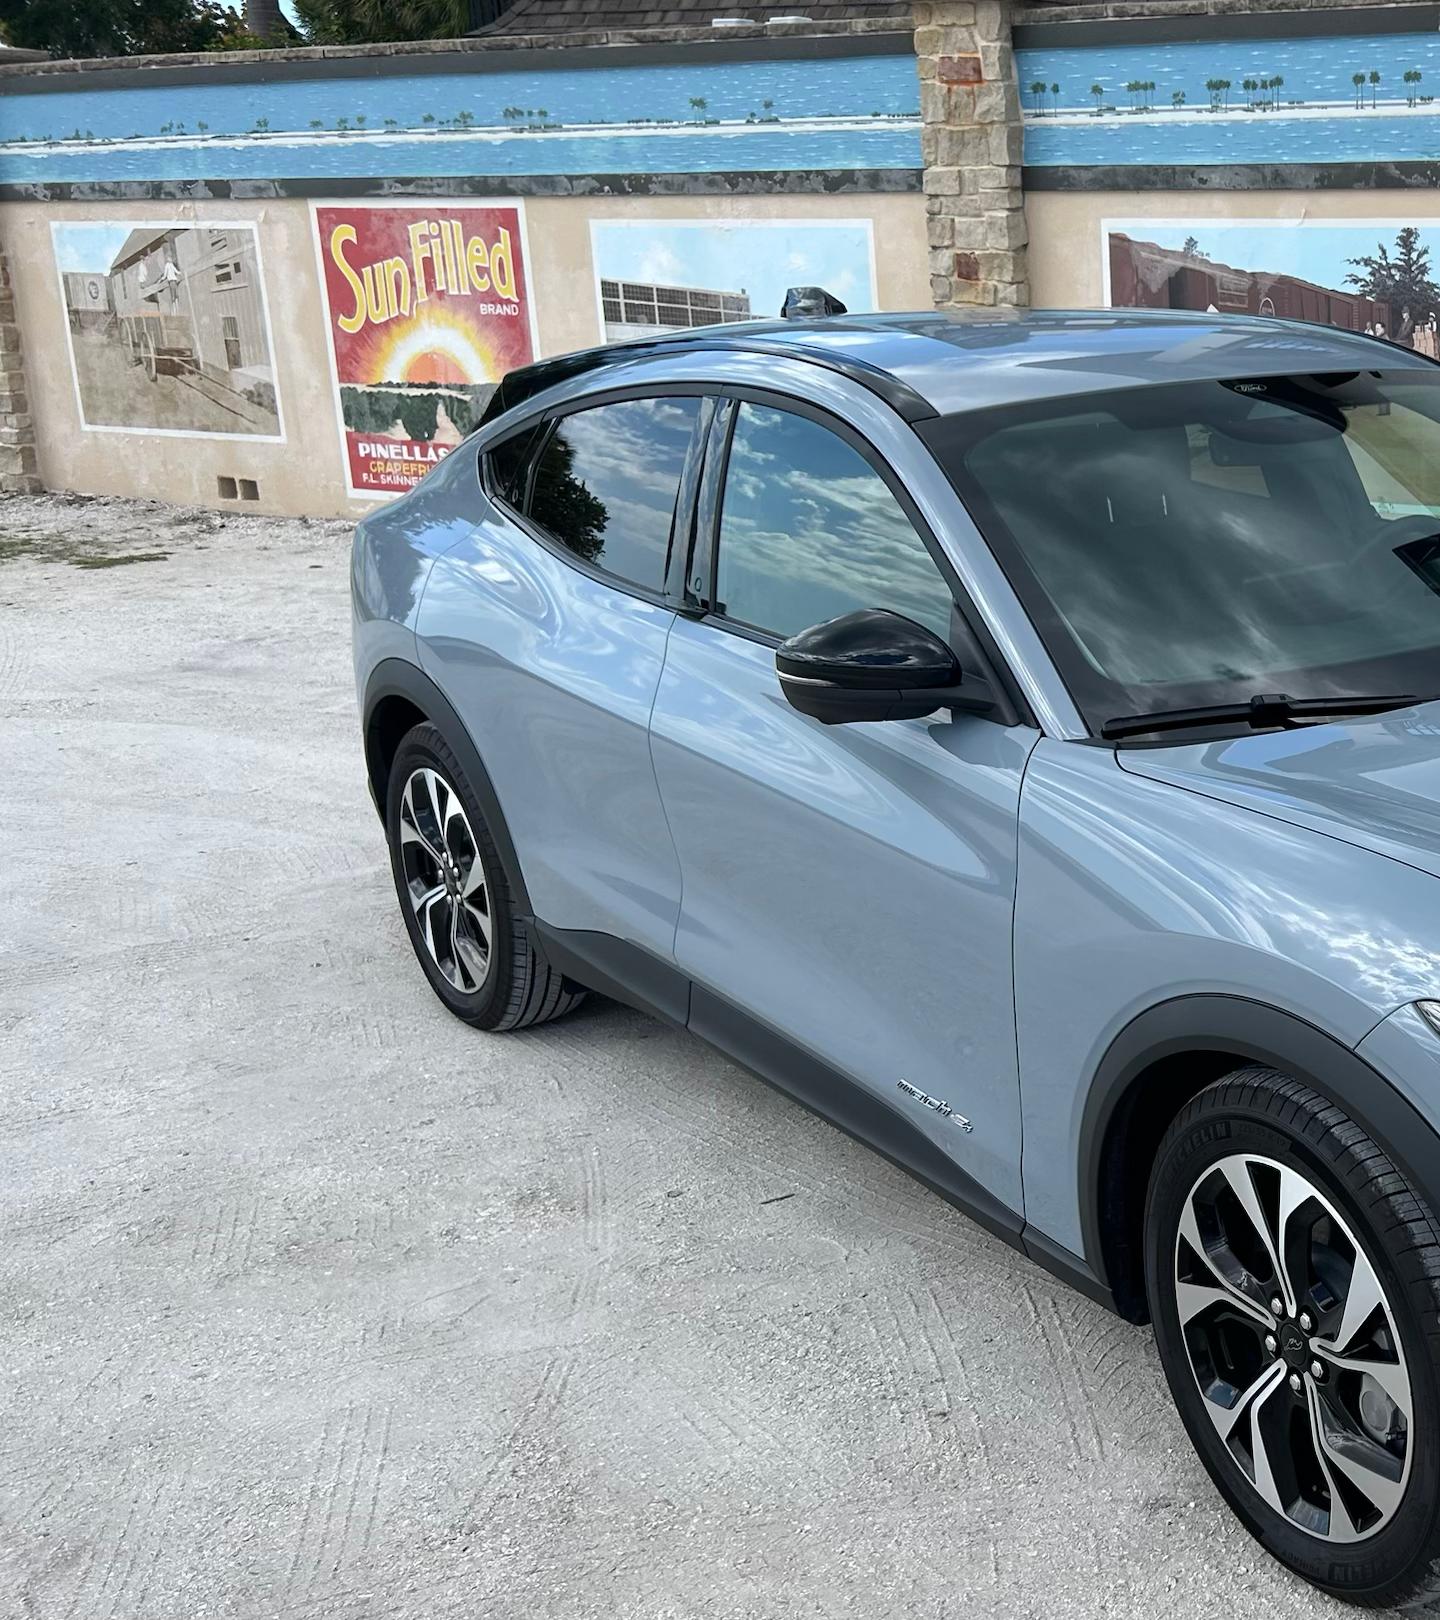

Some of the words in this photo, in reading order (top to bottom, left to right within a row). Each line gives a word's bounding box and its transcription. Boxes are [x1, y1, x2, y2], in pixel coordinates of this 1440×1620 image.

[479, 303, 519, 316] BRAND
[358, 442, 449, 462] PINELLAS
[380, 473, 422, 486] SKINNE
